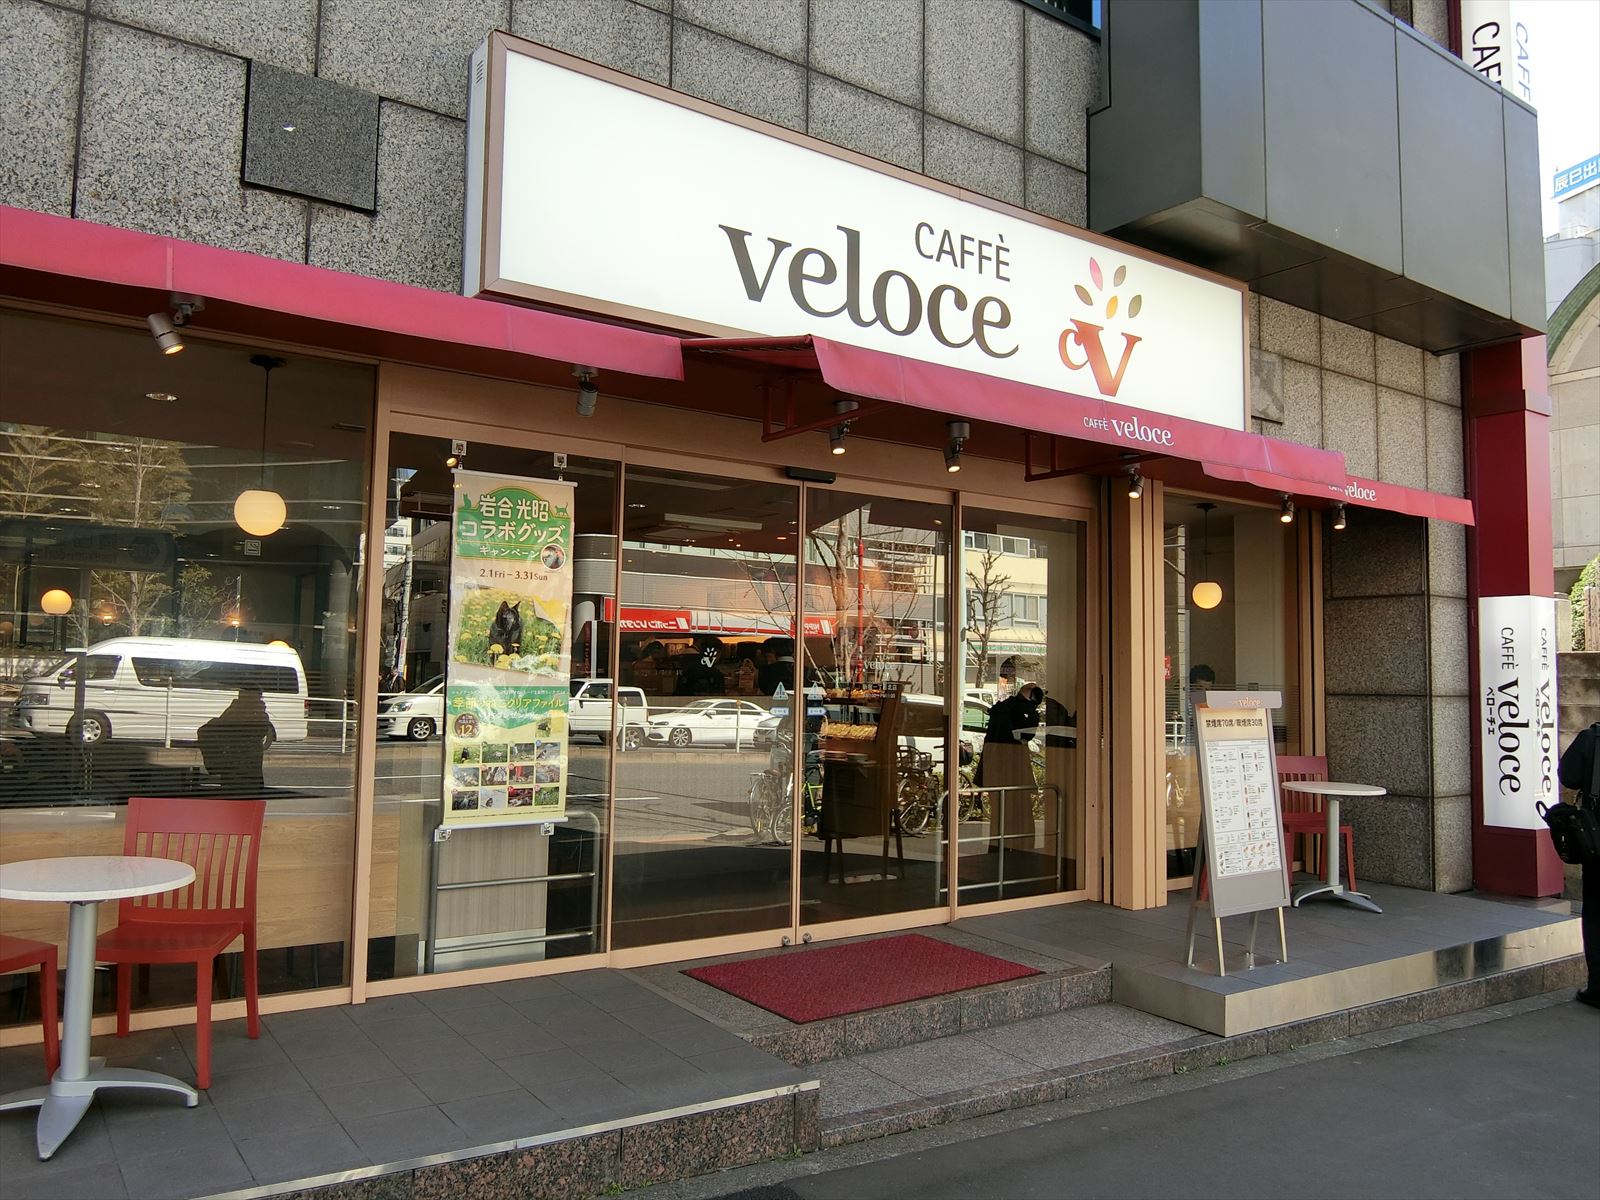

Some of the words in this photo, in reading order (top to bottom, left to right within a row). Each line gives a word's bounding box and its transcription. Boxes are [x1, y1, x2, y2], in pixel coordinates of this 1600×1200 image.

[1472, 21, 1502, 85] CAF
[914, 221, 1011, 283] CAFFÈ
[718, 224, 1019, 359] veloce
[1083, 416, 1109, 431] CAFFÈ
[1110, 416, 1175, 446] veloce
[479, 494, 514, 519] 岩合
[517, 498, 549, 522] 光昭
[461, 519, 566, 544] コラボグッズ
[479, 545, 540, 558] キャンペーン
[1501, 627, 1519, 670] CAFFÈ
[1540, 628, 1550, 671] CAFFÈ
[1498, 677, 1530, 796] veloce
[1540, 678, 1555, 797] veloce
